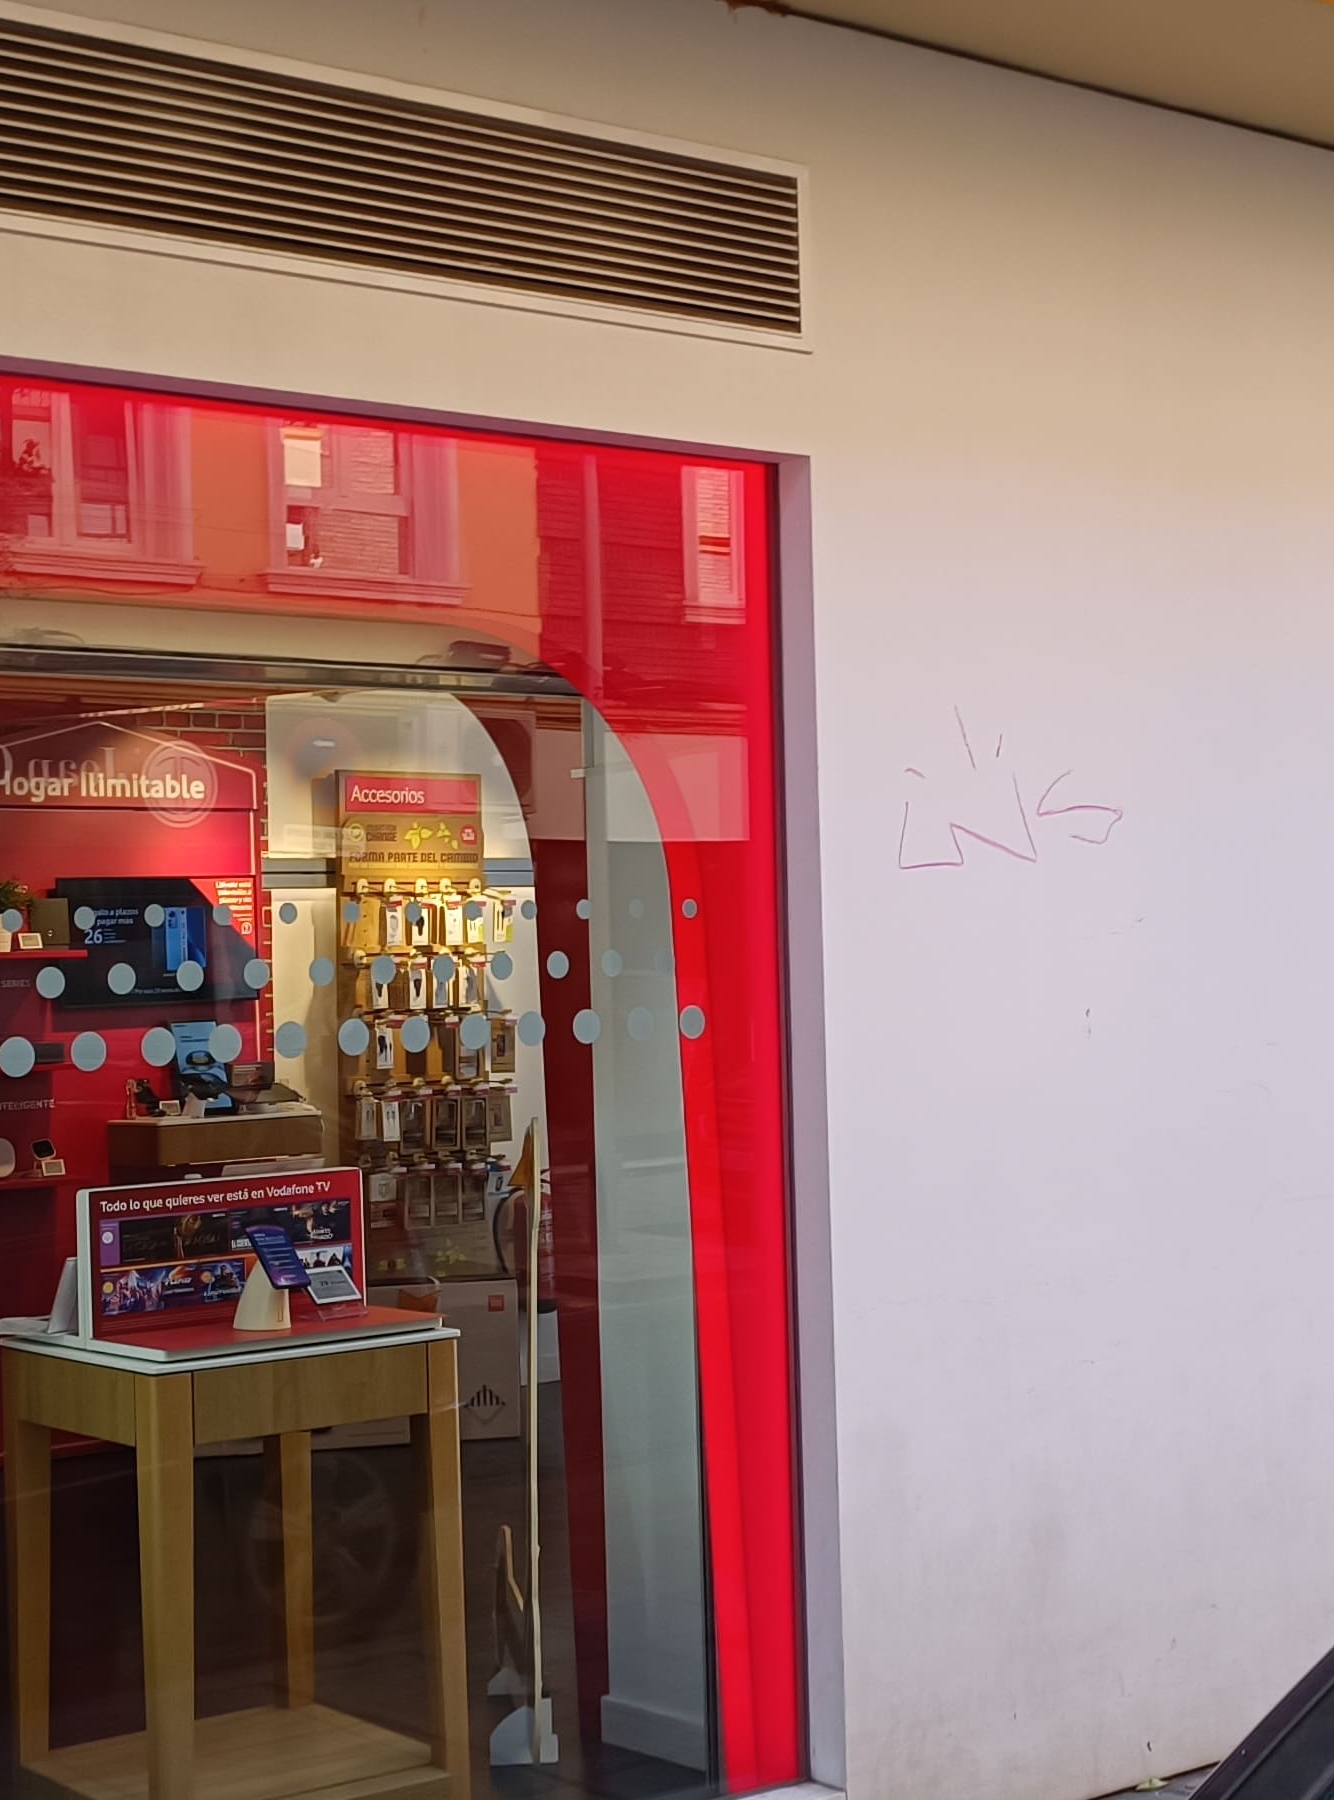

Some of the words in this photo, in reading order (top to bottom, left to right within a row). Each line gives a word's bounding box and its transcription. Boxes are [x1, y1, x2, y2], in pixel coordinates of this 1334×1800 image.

[80, 773, 206, 799] Ilimitable
[350, 785, 425, 804] Accesorios
[349, 852, 384, 863] FORMA
[388, 852, 417, 863] PARTE
[421, 852, 438, 863] DEL
[84, 928, 103, 945] 26
[99, 1200, 127, 1213] Todo
[129, 1199, 140, 1210] lo
[142, 1199, 163, 1212] que
[165, 1194, 205, 1210] quieres
[207, 1193, 224, 1203] ver
[226, 1188, 249, 1201] está
[251, 1189, 265, 1199] en
[267, 1183, 315, 1198] Vodafone
[316, 1181, 331, 1193] TV
